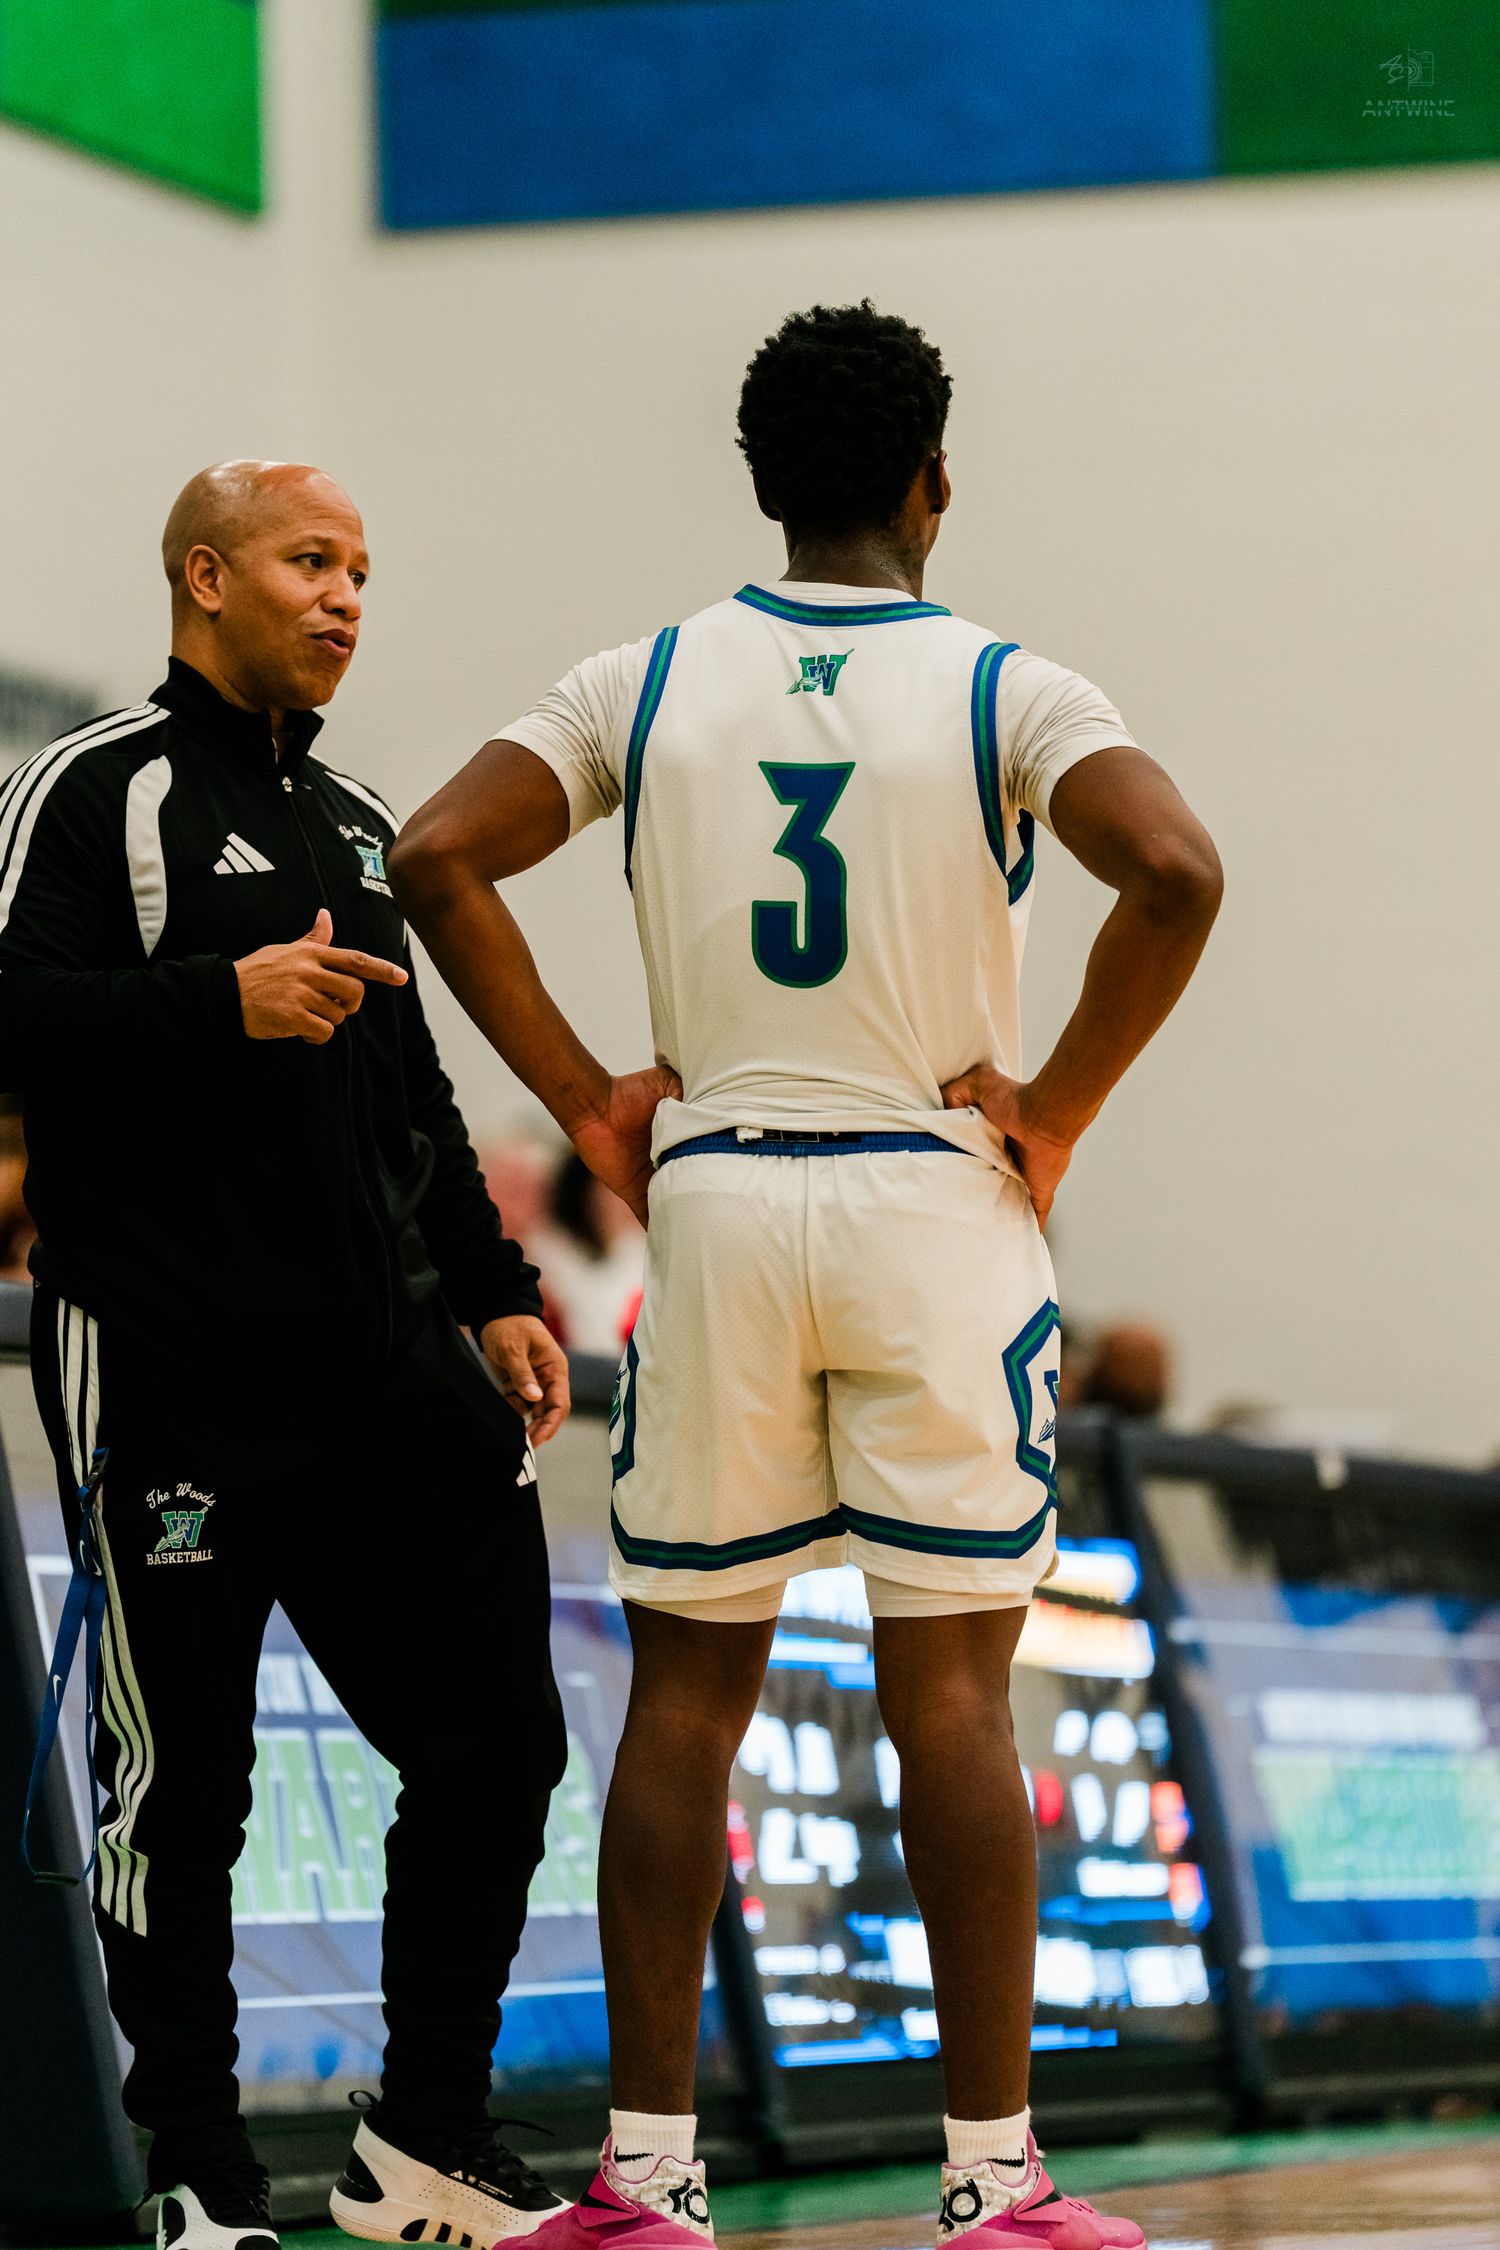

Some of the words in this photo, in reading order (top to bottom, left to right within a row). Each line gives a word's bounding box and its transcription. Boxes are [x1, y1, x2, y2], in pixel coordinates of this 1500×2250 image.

[751, 760, 856, 989] 3
[145, 1488, 171, 1509] The
[176, 1482, 216, 1507] Woods
[146, 1549, 213, 1565] BASKETBALL
